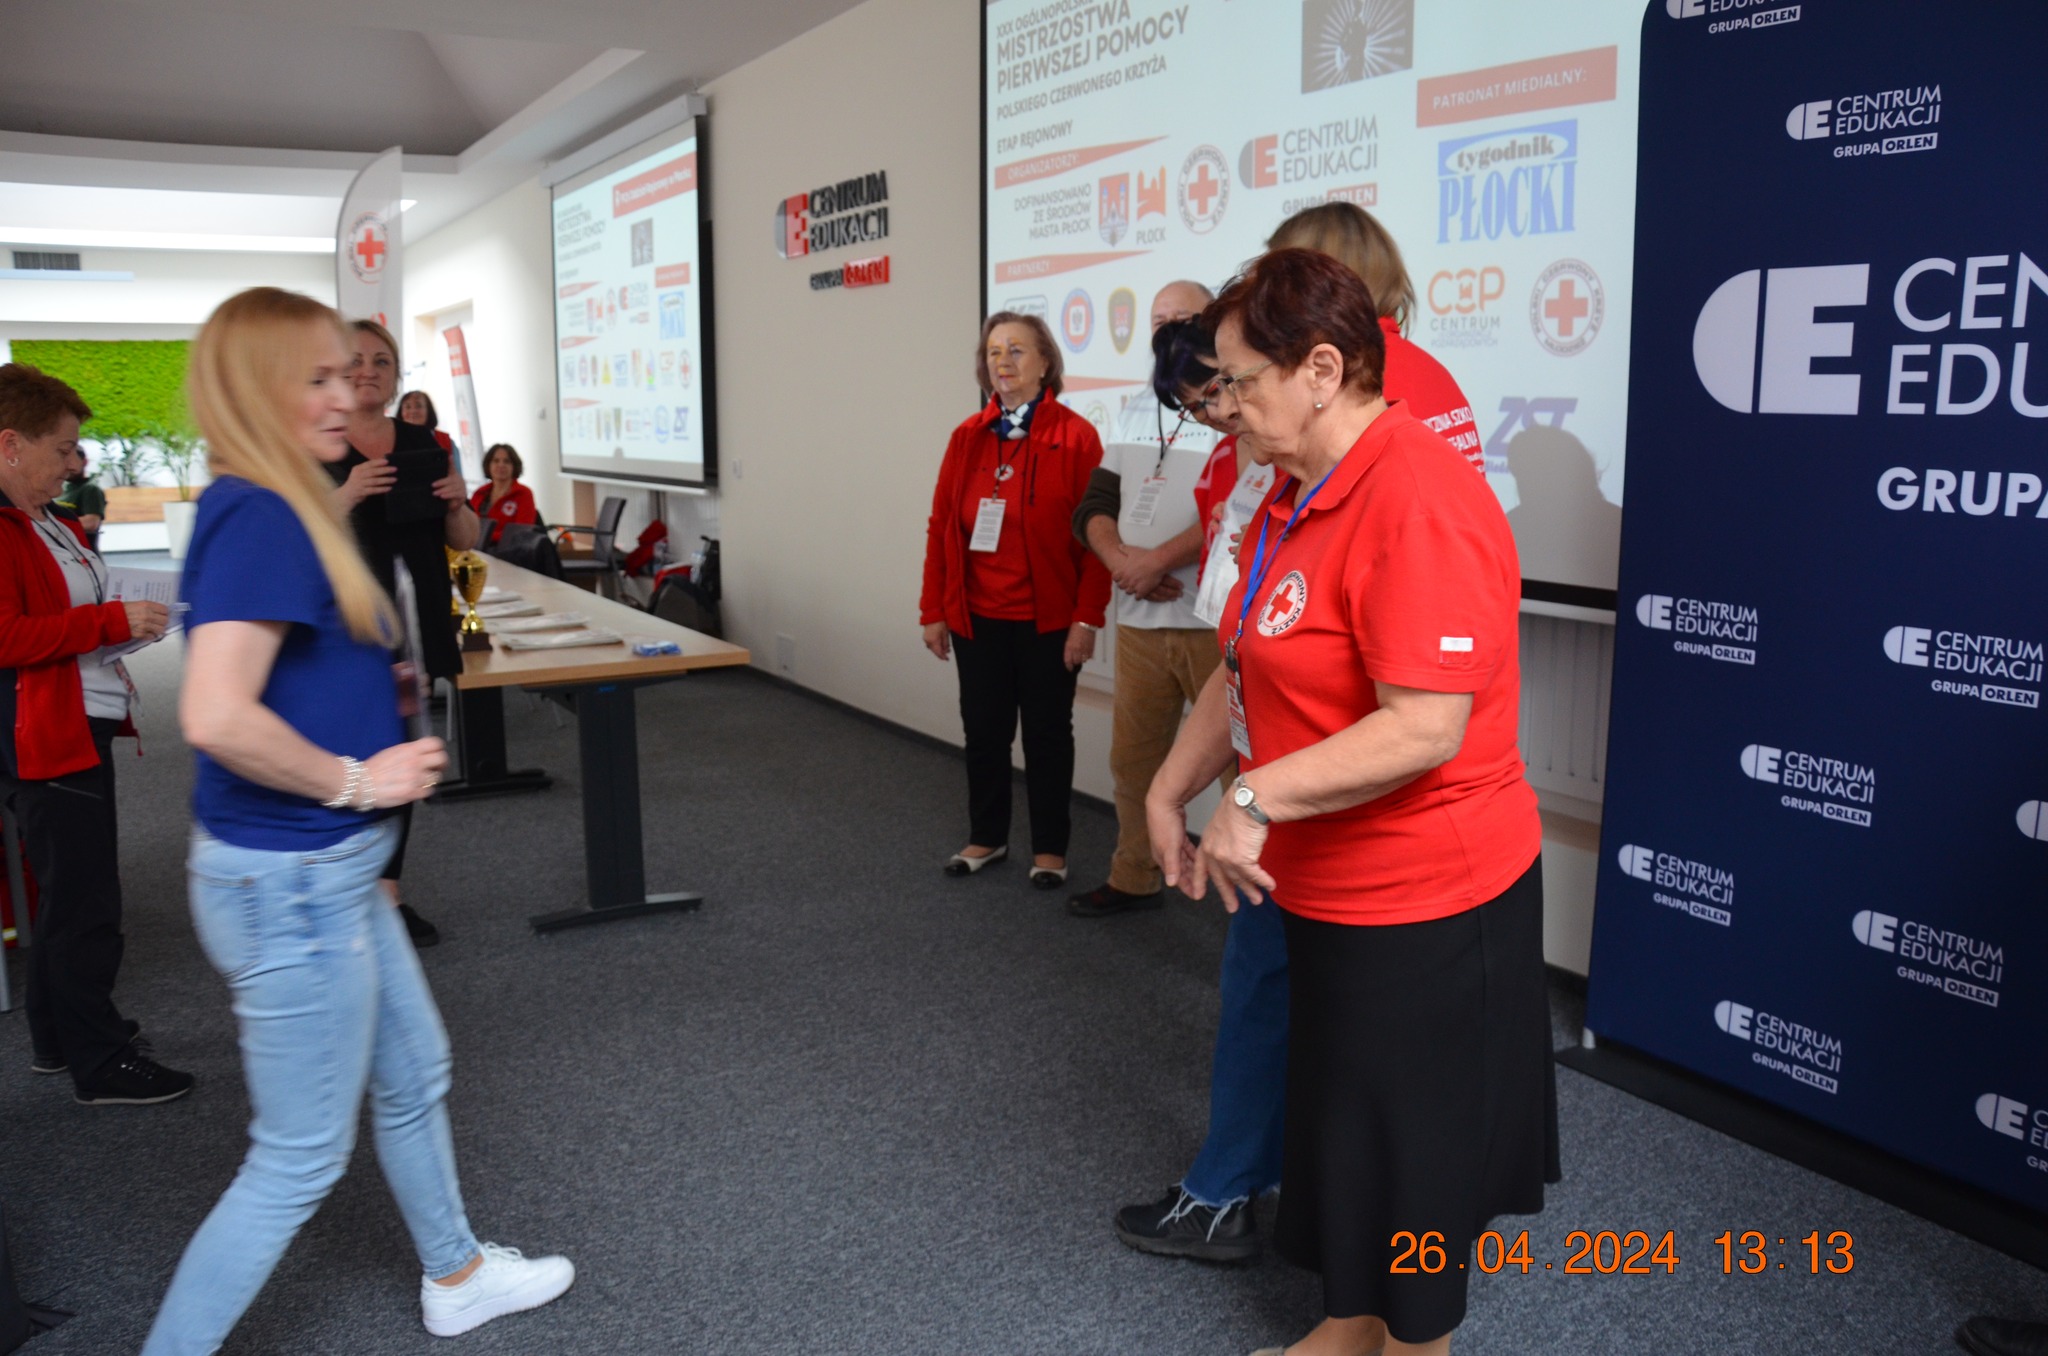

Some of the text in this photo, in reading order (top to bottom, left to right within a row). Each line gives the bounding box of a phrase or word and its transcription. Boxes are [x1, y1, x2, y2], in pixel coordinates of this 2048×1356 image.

[997, 20, 1014, 39] XXX
[997, 0, 1131, 65] MISTRZOSTWA
[1708, 8, 1798, 34] GRUPA ORLEN
[998, 5, 1189, 94] PIERWSZEJ POMOCY
[996, 53, 1167, 120] POLSKIEGO CZERWONEGO KRZYŻA
[1433, 83, 1501, 110] PATRONAT
[1837, 84, 1942, 116] CENTRUM
[997, 120, 1073, 154] ETAP REJONOWY
[1283, 115, 1378, 156] CENTRUM
[1835, 105, 1941, 136] EDUKACJI
[1283, 143, 1378, 184] EDUKACJI
[1457, 135, 1555, 172] tygodnik
[1833, 134, 1935, 158] GRUPA ORLEN
[809, 169, 888, 219] CENTRUM
[1437, 160, 1578, 244] PŁOCKI
[810, 206, 888, 252] EDUKACJI
[1430, 315, 1500, 332] CENTRUM
[1675, 615, 1757, 643] EDUKACJI
[1676, 598, 1758, 625] CENTRUM
[1674, 641, 1753, 663] GRUPA ORLEN
[1936, 631, 2044, 662] CENTRUM
[1934, 650, 2043, 682] EDUKACJI
[1931, 679, 2036, 707] GRUPA ORLEN
[1785, 751, 1875, 785] CENTRUM
[1783, 768, 1874, 804] EDUKACJI
[1781, 795, 1869, 825] GRUPA ORLEN
[1655, 868, 1733, 905] EDUKACJI
[1656, 853, 1734, 888] CENTRUM
[1653, 892, 1729, 924] GRUPA ORLEN
[1902, 921, 2004, 964] CENTRUM
[1900, 939, 2002, 983] EDUKACJI
[1897, 966, 1997, 1005] GRUPA ORLEN
[1755, 1028, 1841, 1073] EDUKACJI
[1757, 1012, 1842, 1056] CENTRUM
[1752, 1052, 1836, 1092] GRUPA ORLEN
